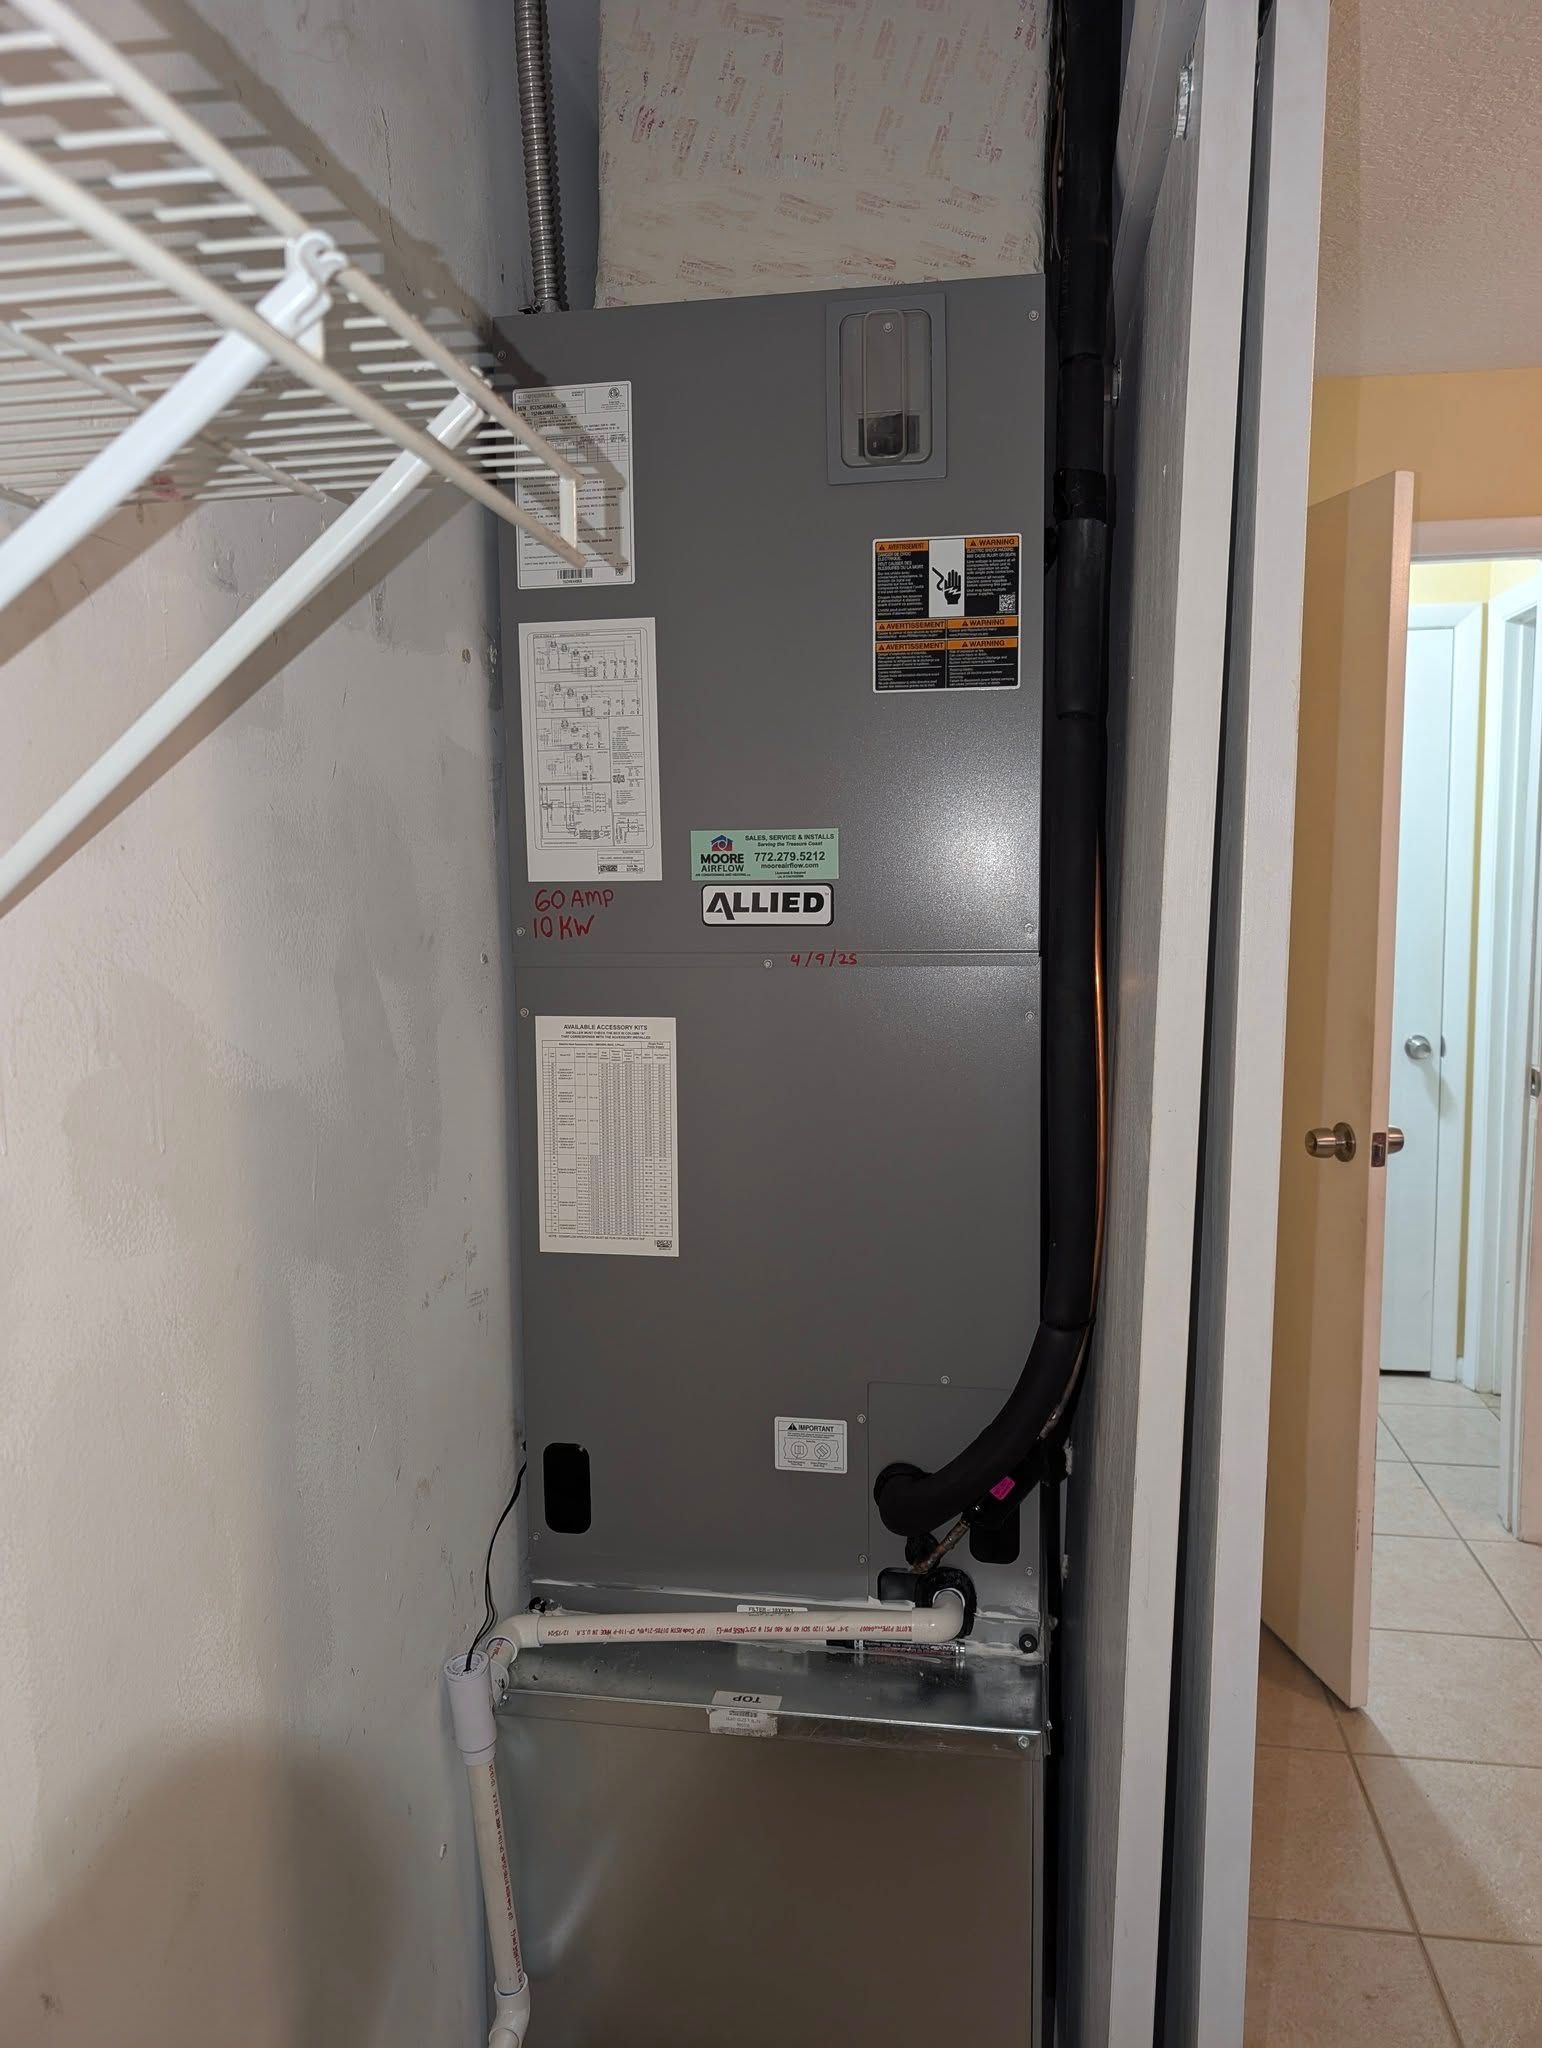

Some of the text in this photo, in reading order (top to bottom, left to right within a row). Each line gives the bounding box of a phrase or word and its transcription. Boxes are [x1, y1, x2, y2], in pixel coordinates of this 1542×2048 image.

[979, 538, 1015, 546] WARNING
[886, 642, 944, 650] AVERTISSEMENT
[969, 640, 1005, 648] WARNING
[701, 854, 744, 864] MOORE
[754, 851, 825, 862] 772.279.5212
[701, 864, 744, 872] AIRFLOW
[535, 888, 565, 912] 60
[706, 892, 824, 920] ALLIED
[534, 914, 594, 940] 10 KW
[790, 949, 858, 967] 4/9/25
[732, 1696, 762, 1704] TOP
